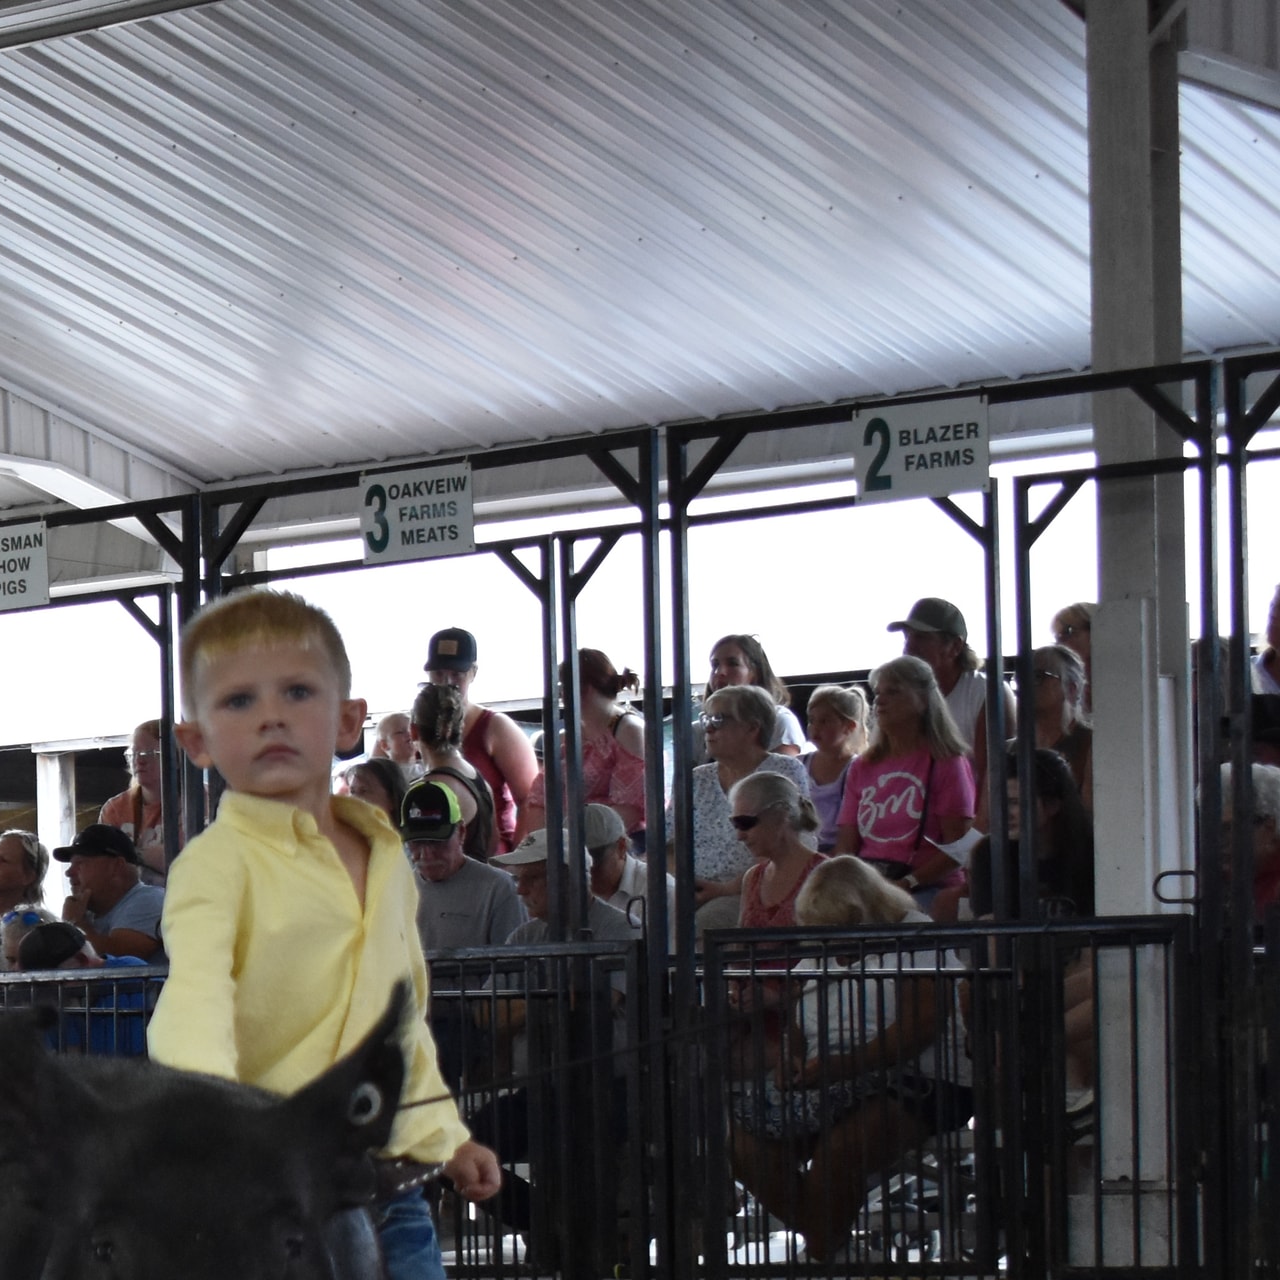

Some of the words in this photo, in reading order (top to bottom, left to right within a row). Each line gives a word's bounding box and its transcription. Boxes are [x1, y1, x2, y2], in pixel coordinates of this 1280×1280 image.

[899, 422, 979, 447] BLAZER
[863, 417, 892, 492] 2
[904, 448, 975, 471] FARMS
[388, 475, 467, 500] OAKVEIW
[365, 484, 389, 553] 3
[398, 500, 458, 522] FARMS
[401, 524, 459, 546] MEATS
